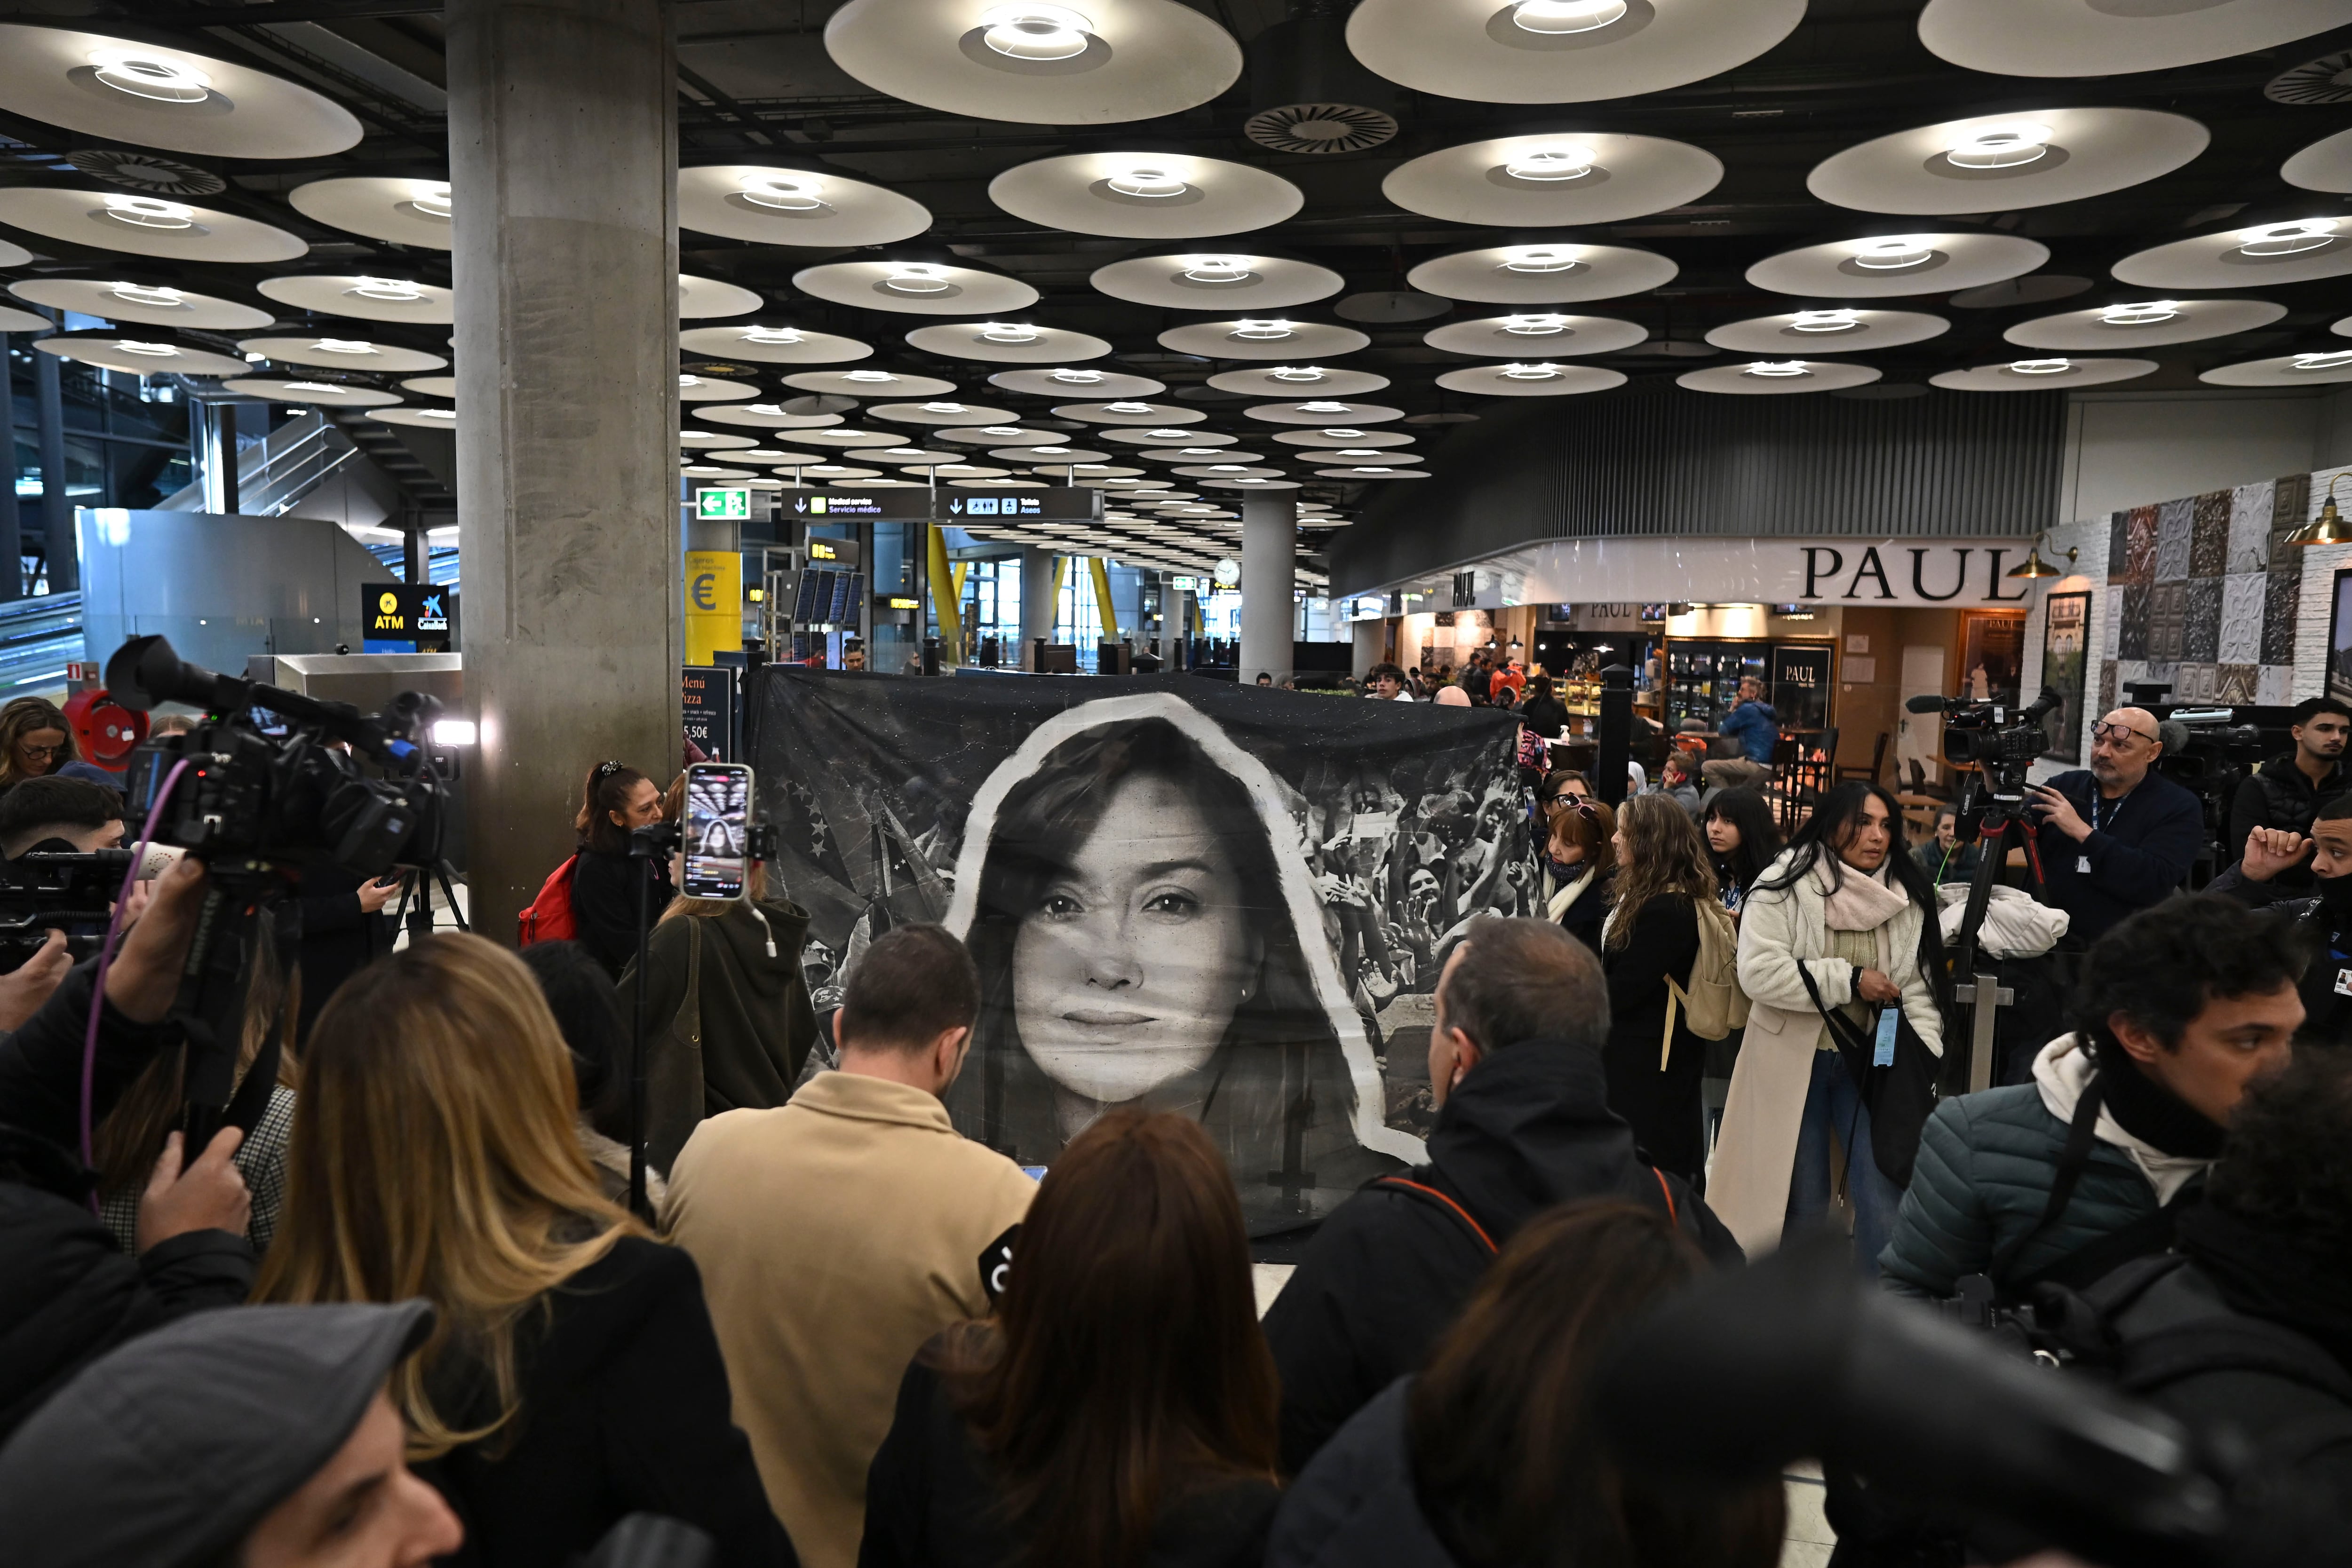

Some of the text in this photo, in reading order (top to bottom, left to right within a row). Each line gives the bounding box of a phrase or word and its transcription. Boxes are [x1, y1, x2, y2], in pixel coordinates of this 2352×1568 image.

[1799, 546, 2028, 601] PAUL
[375, 615, 404, 629] ATM
[1786, 665, 1815, 682] PAUL
[1962, 794, 1971, 816] Canon
